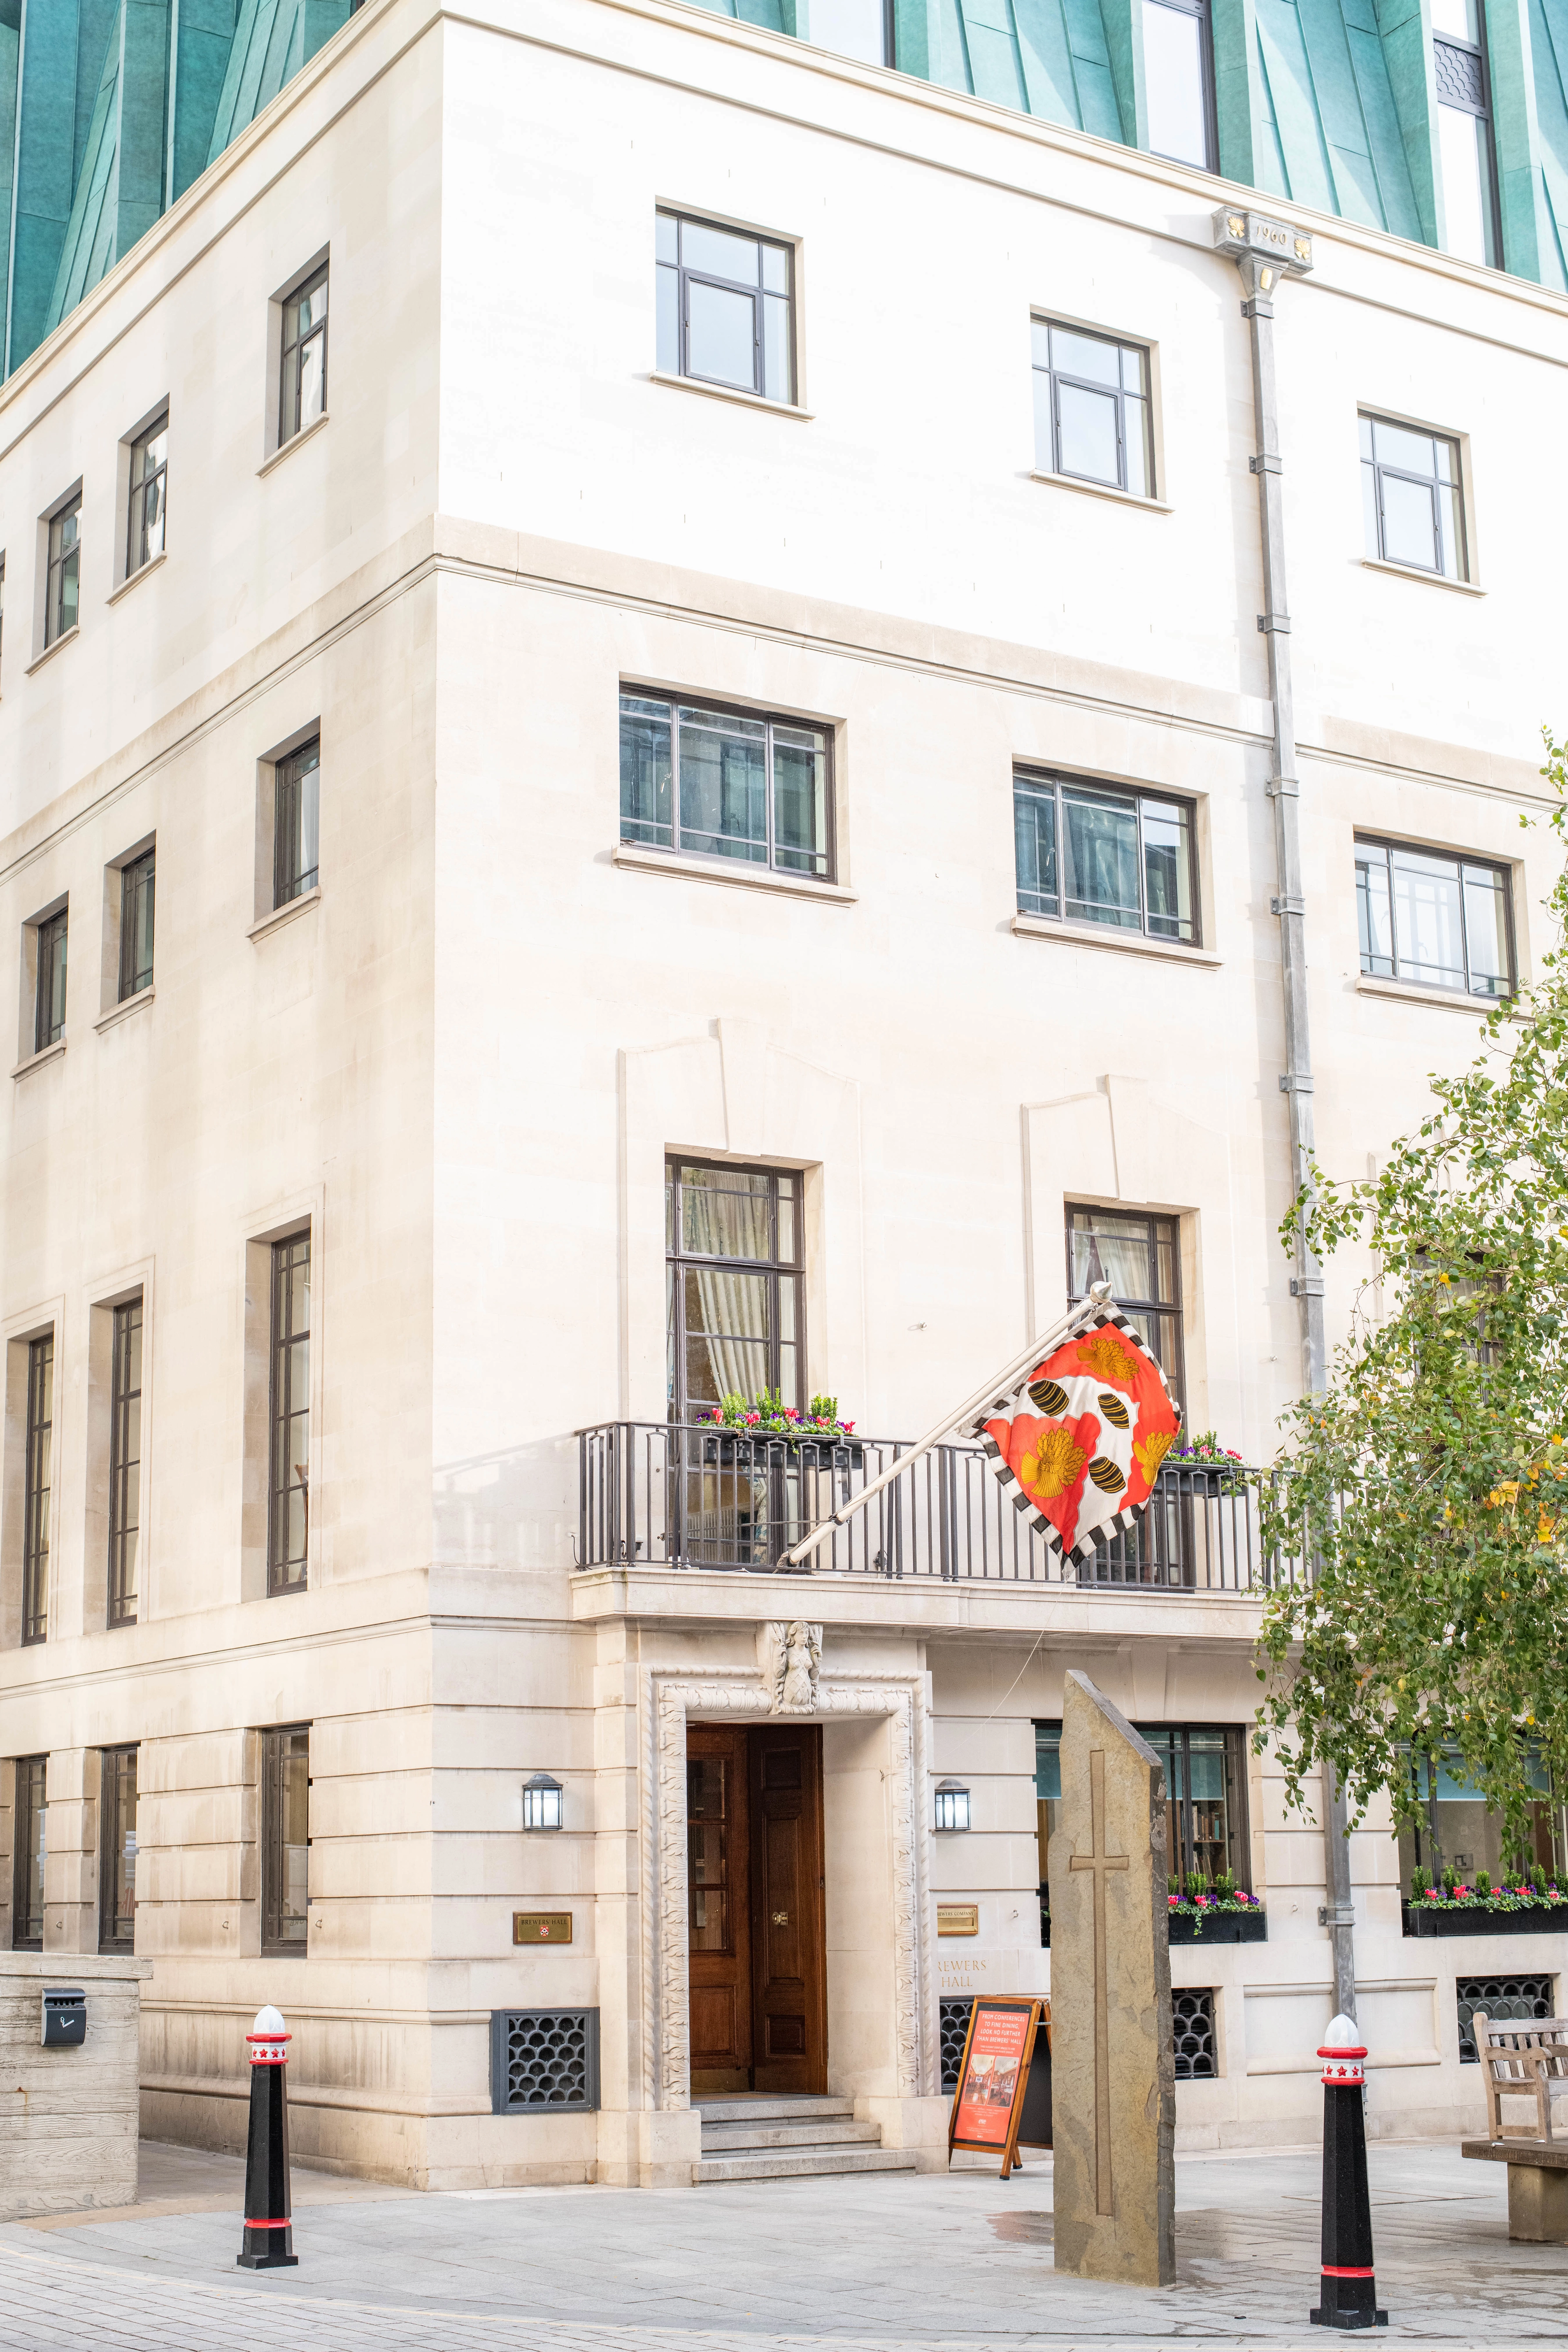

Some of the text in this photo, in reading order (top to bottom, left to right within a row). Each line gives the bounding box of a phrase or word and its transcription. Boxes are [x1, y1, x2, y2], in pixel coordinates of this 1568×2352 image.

[1256, 225, 1287, 245] 1960
[938, 1960, 986, 1971] REWERS
[942, 1976, 973, 1987] HALL
[1495, 2149, 1510, 2159] PRIORY
